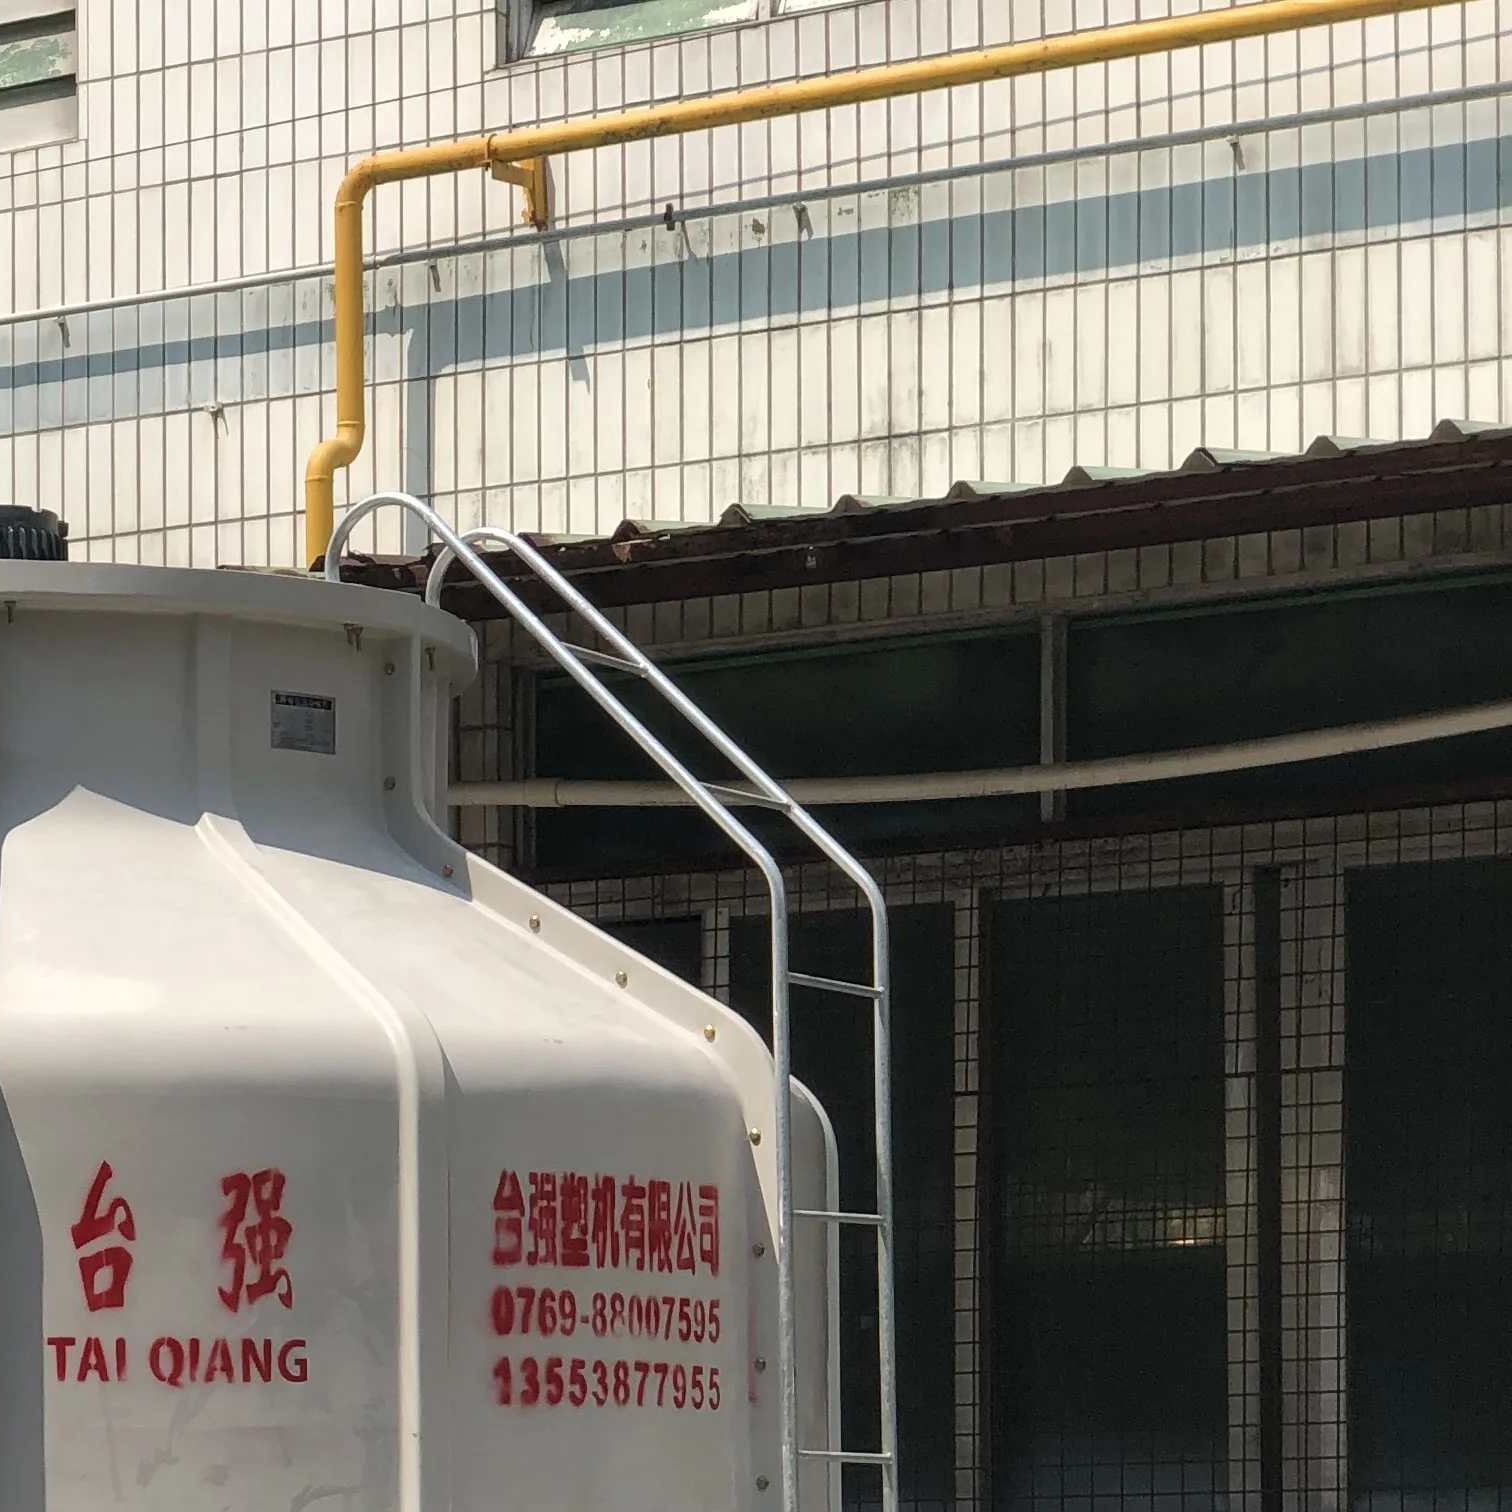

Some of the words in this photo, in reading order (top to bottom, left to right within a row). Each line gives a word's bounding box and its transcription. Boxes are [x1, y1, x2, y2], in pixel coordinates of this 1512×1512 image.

[492, 1170, 720, 1277] 台强塑机有限公司
[491, 1285, 720, 1343] 0769-88007595
[47, 1337, 126, 1381] TAI
[148, 1337, 308, 1387] QIANG
[492, 1356, 720, 1410] 13553877955
